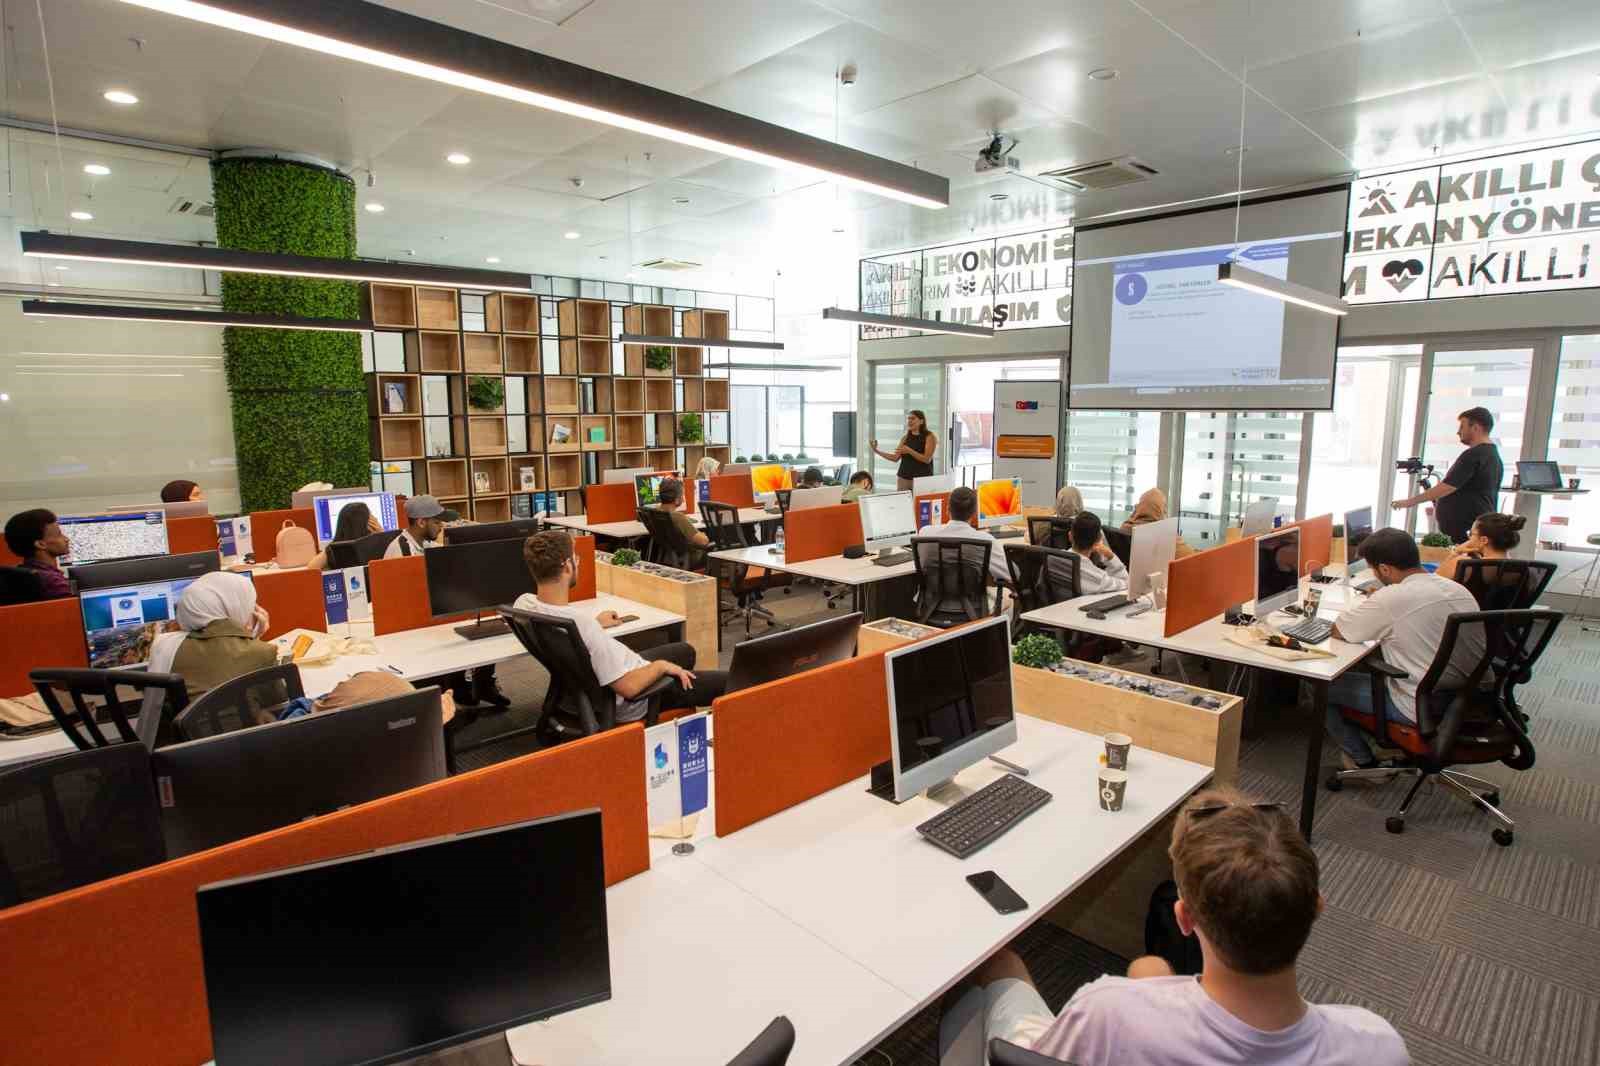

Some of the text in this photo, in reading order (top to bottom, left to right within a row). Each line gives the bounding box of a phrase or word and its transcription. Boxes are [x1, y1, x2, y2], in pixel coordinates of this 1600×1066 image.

[1404, 158, 1564, 209] AKILLI
[1346, 197, 1600, 254] EKANYÖNE
[934, 233, 1047, 277] EKONOMİ
[981, 267, 1049, 296] AKILLI
[950, 300, 1039, 328] ULAŞIM
